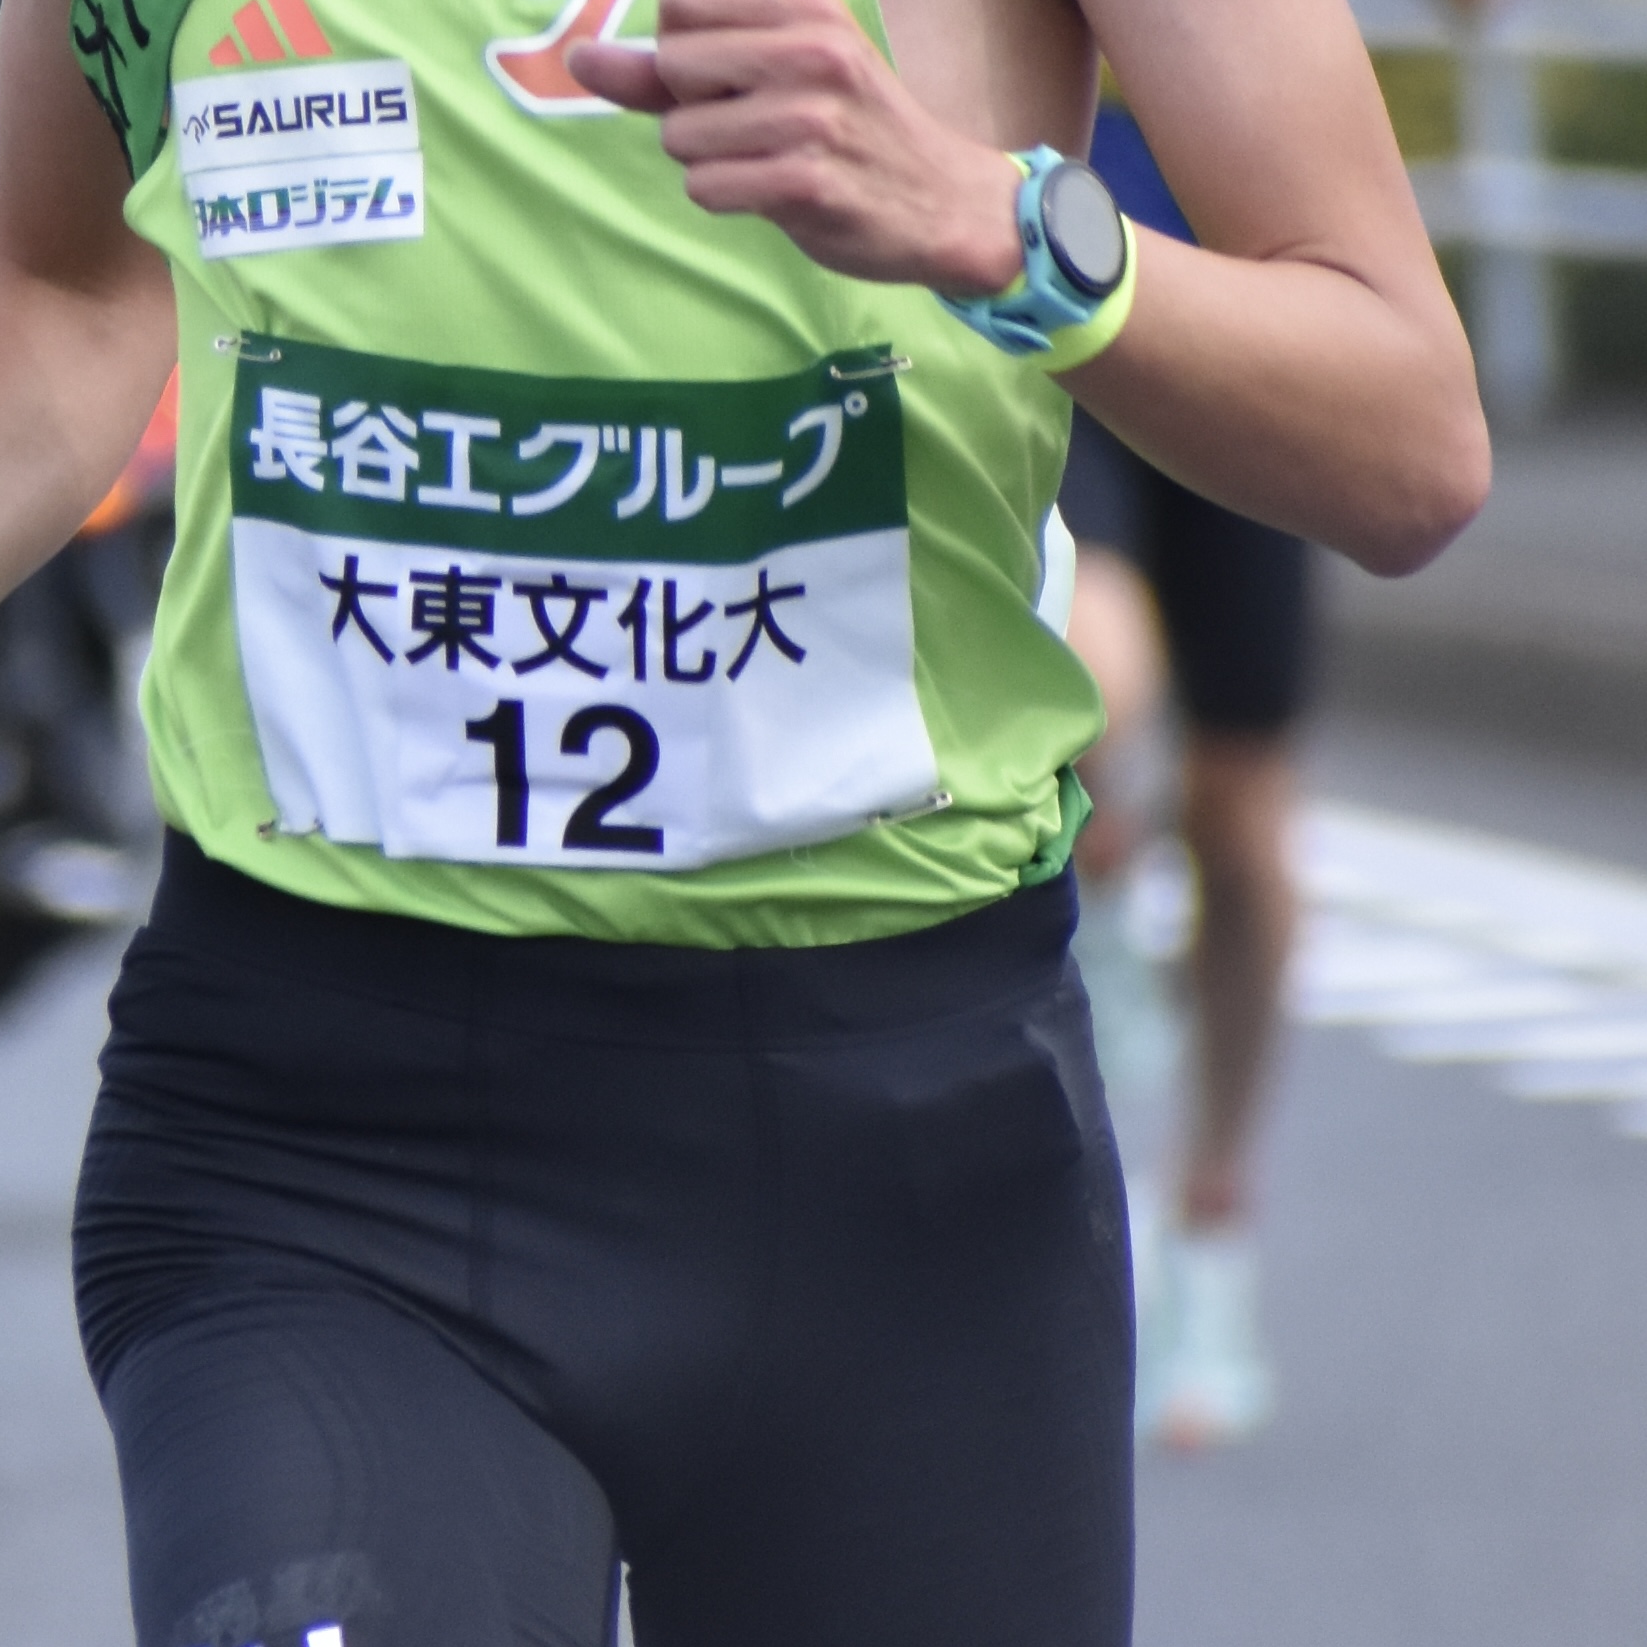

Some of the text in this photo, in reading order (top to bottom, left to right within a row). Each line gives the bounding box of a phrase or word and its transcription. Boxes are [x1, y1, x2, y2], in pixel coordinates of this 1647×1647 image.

[213, 88, 408, 139] SAURUS
[318, 554, 807, 685] 大東文化大
[465, 698, 665, 854] 12
